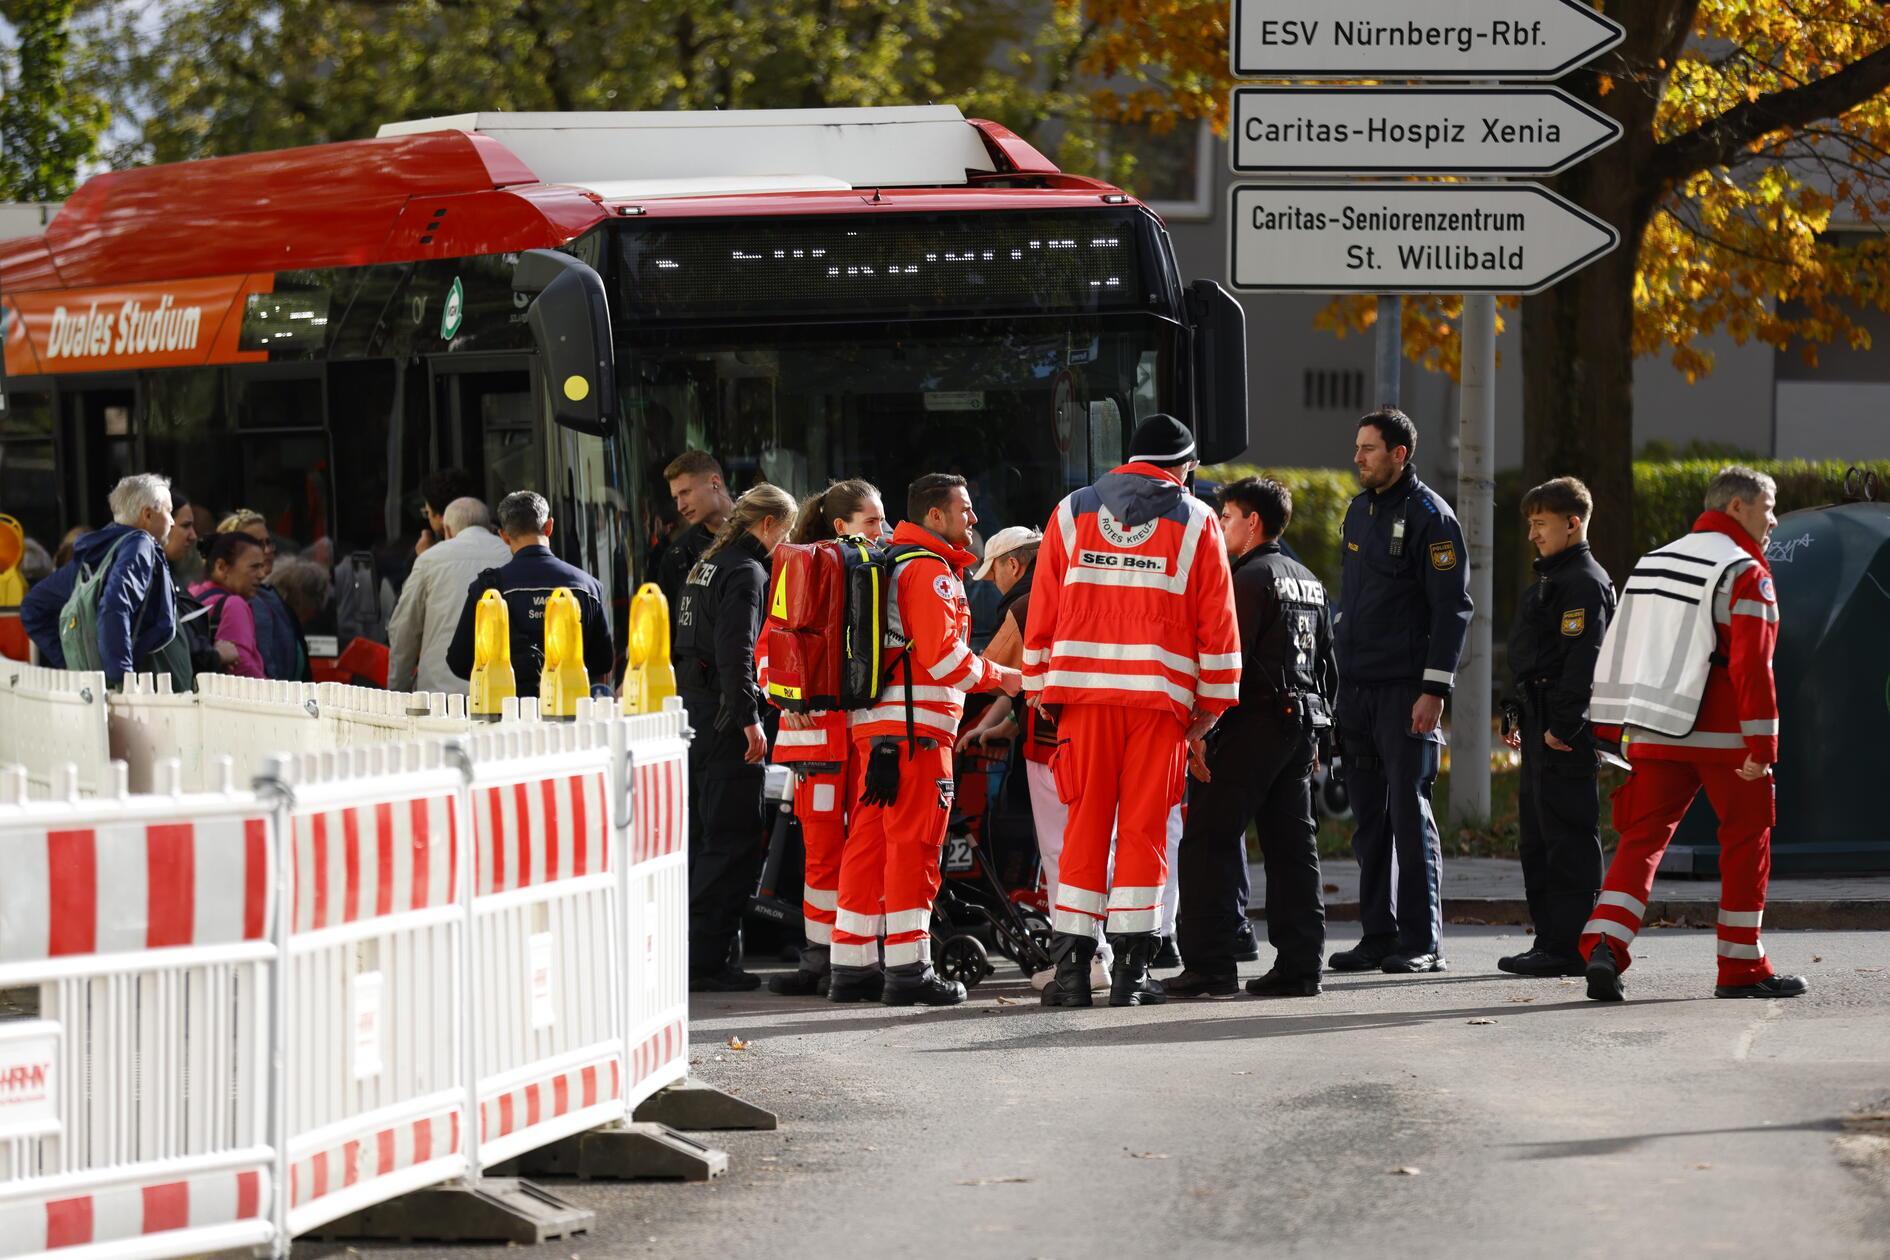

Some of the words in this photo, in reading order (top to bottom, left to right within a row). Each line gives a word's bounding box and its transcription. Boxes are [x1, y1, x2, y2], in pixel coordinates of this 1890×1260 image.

[1261, 21, 1319, 46] ESV
[1334, 20, 1546, 52] Nürnberg-Rbf.
[1245, 117, 1465, 148] Caritas-Hospiz
[1481, 118, 1561, 143] Xenia
[1252, 206, 1525, 231] Caritas-Seniorenzentrum
[1346, 246, 1382, 270] St.
[1398, 246, 1525, 270] Willibald
[46, 301, 114, 358] Duales
[114, 294, 202, 355] Studium
[1102, 518, 1123, 543] ROTES
[1127, 521, 1153, 544] KREUZ
[1083, 553, 1118, 565] SEG
[1123, 557, 1161, 569] Beh.
